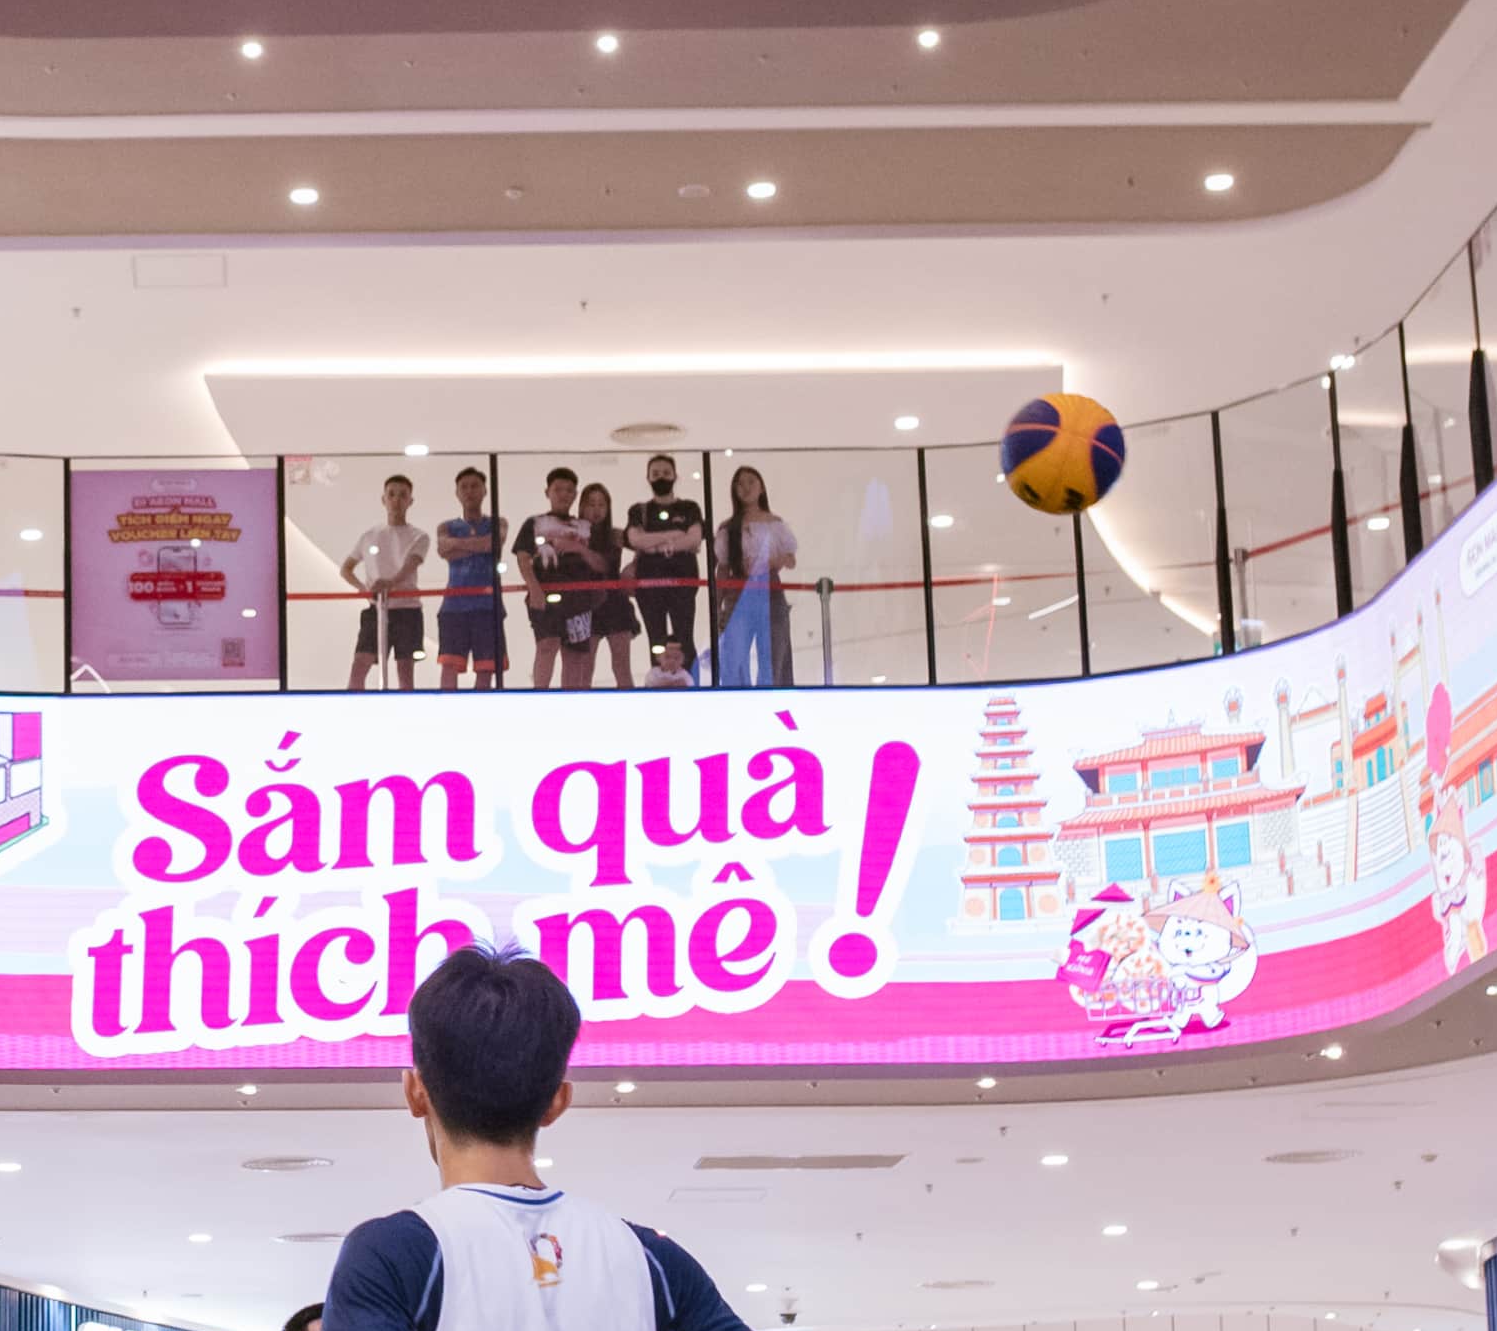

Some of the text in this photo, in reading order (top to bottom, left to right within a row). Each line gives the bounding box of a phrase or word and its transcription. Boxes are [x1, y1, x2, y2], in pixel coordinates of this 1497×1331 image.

[110, 529, 178, 541] VOUCHER
[131, 710, 833, 887] Sắm quà
[86, 887, 476, 1039] thích
[533, 861, 779, 1003] mê
